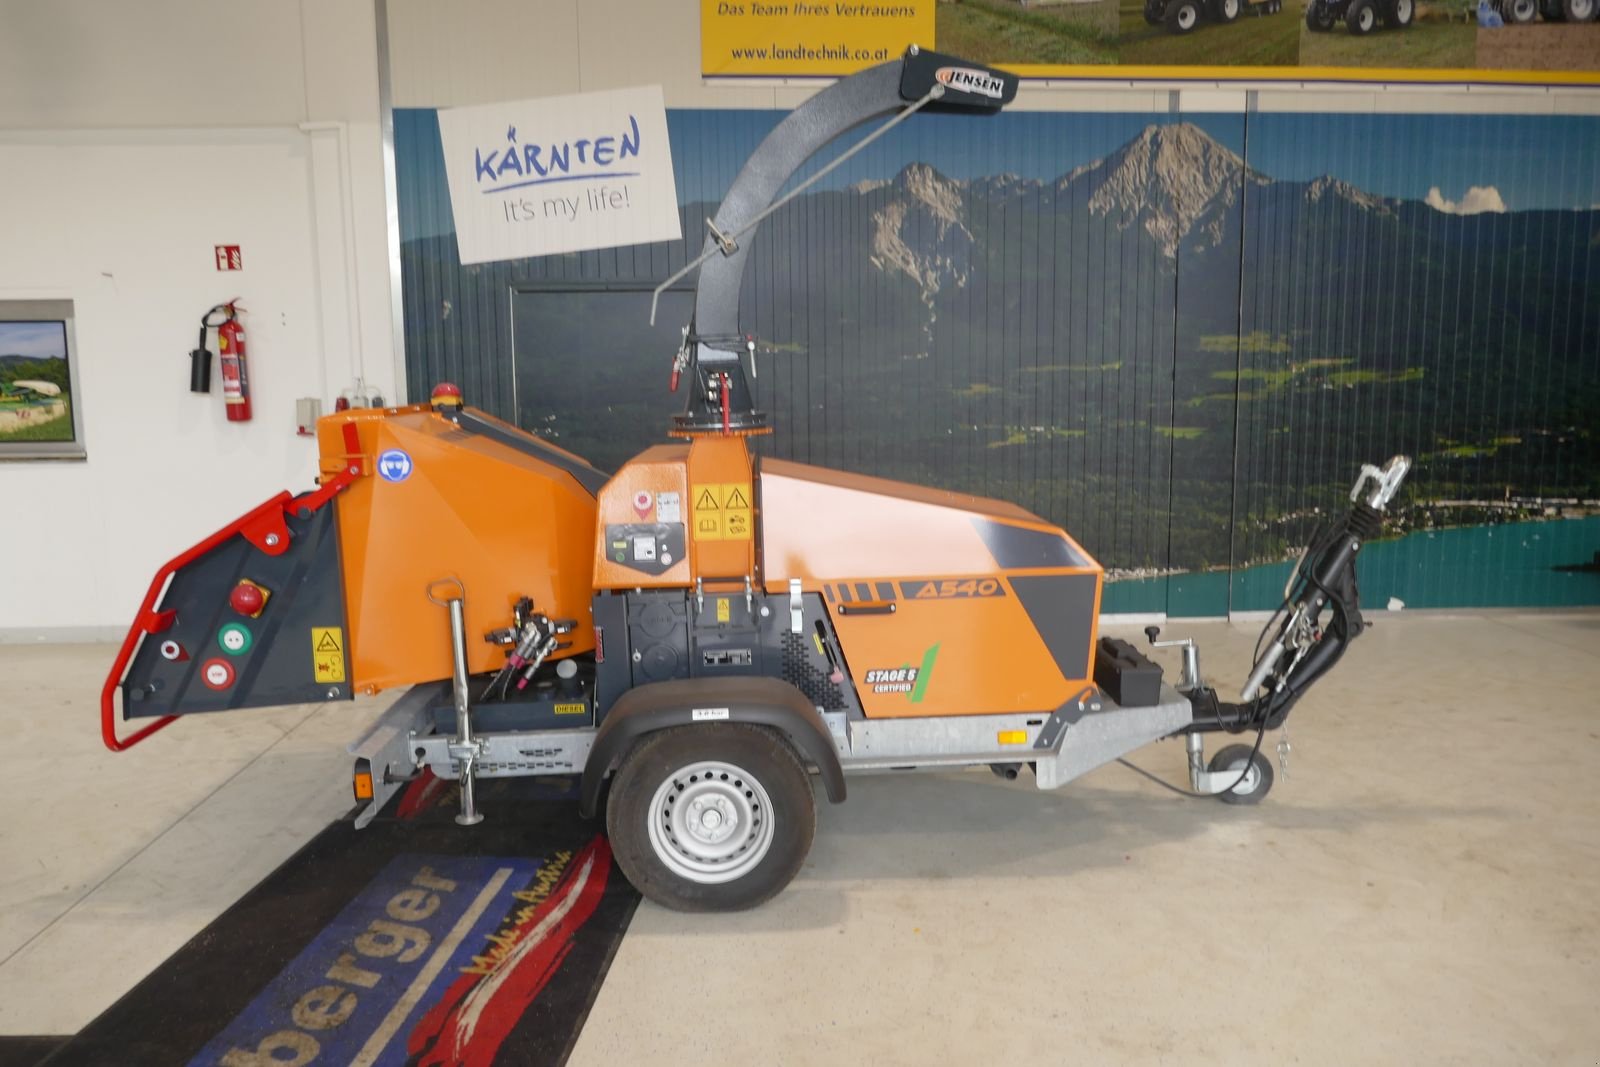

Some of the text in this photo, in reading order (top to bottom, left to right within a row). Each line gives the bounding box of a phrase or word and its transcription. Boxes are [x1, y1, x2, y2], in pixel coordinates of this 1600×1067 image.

[717, 2, 915, 17] Das Team Ihres Vertrauens
[731, 42, 888, 61] www.landtechnik.co.at
[949, 71, 1001, 92] JENSEN
[475, 114, 640, 183] KÄRNTEN
[503, 185, 630, 222] It's my life!
[915, 581, 998, 597] A540
[866, 669, 906, 683] STAGE
[874, 683, 911, 693] CERTIFIED
[556, 705, 584, 713] DIESEL
[458, 929, 521, 977] Made
[221, 865, 459, 1067] berger
